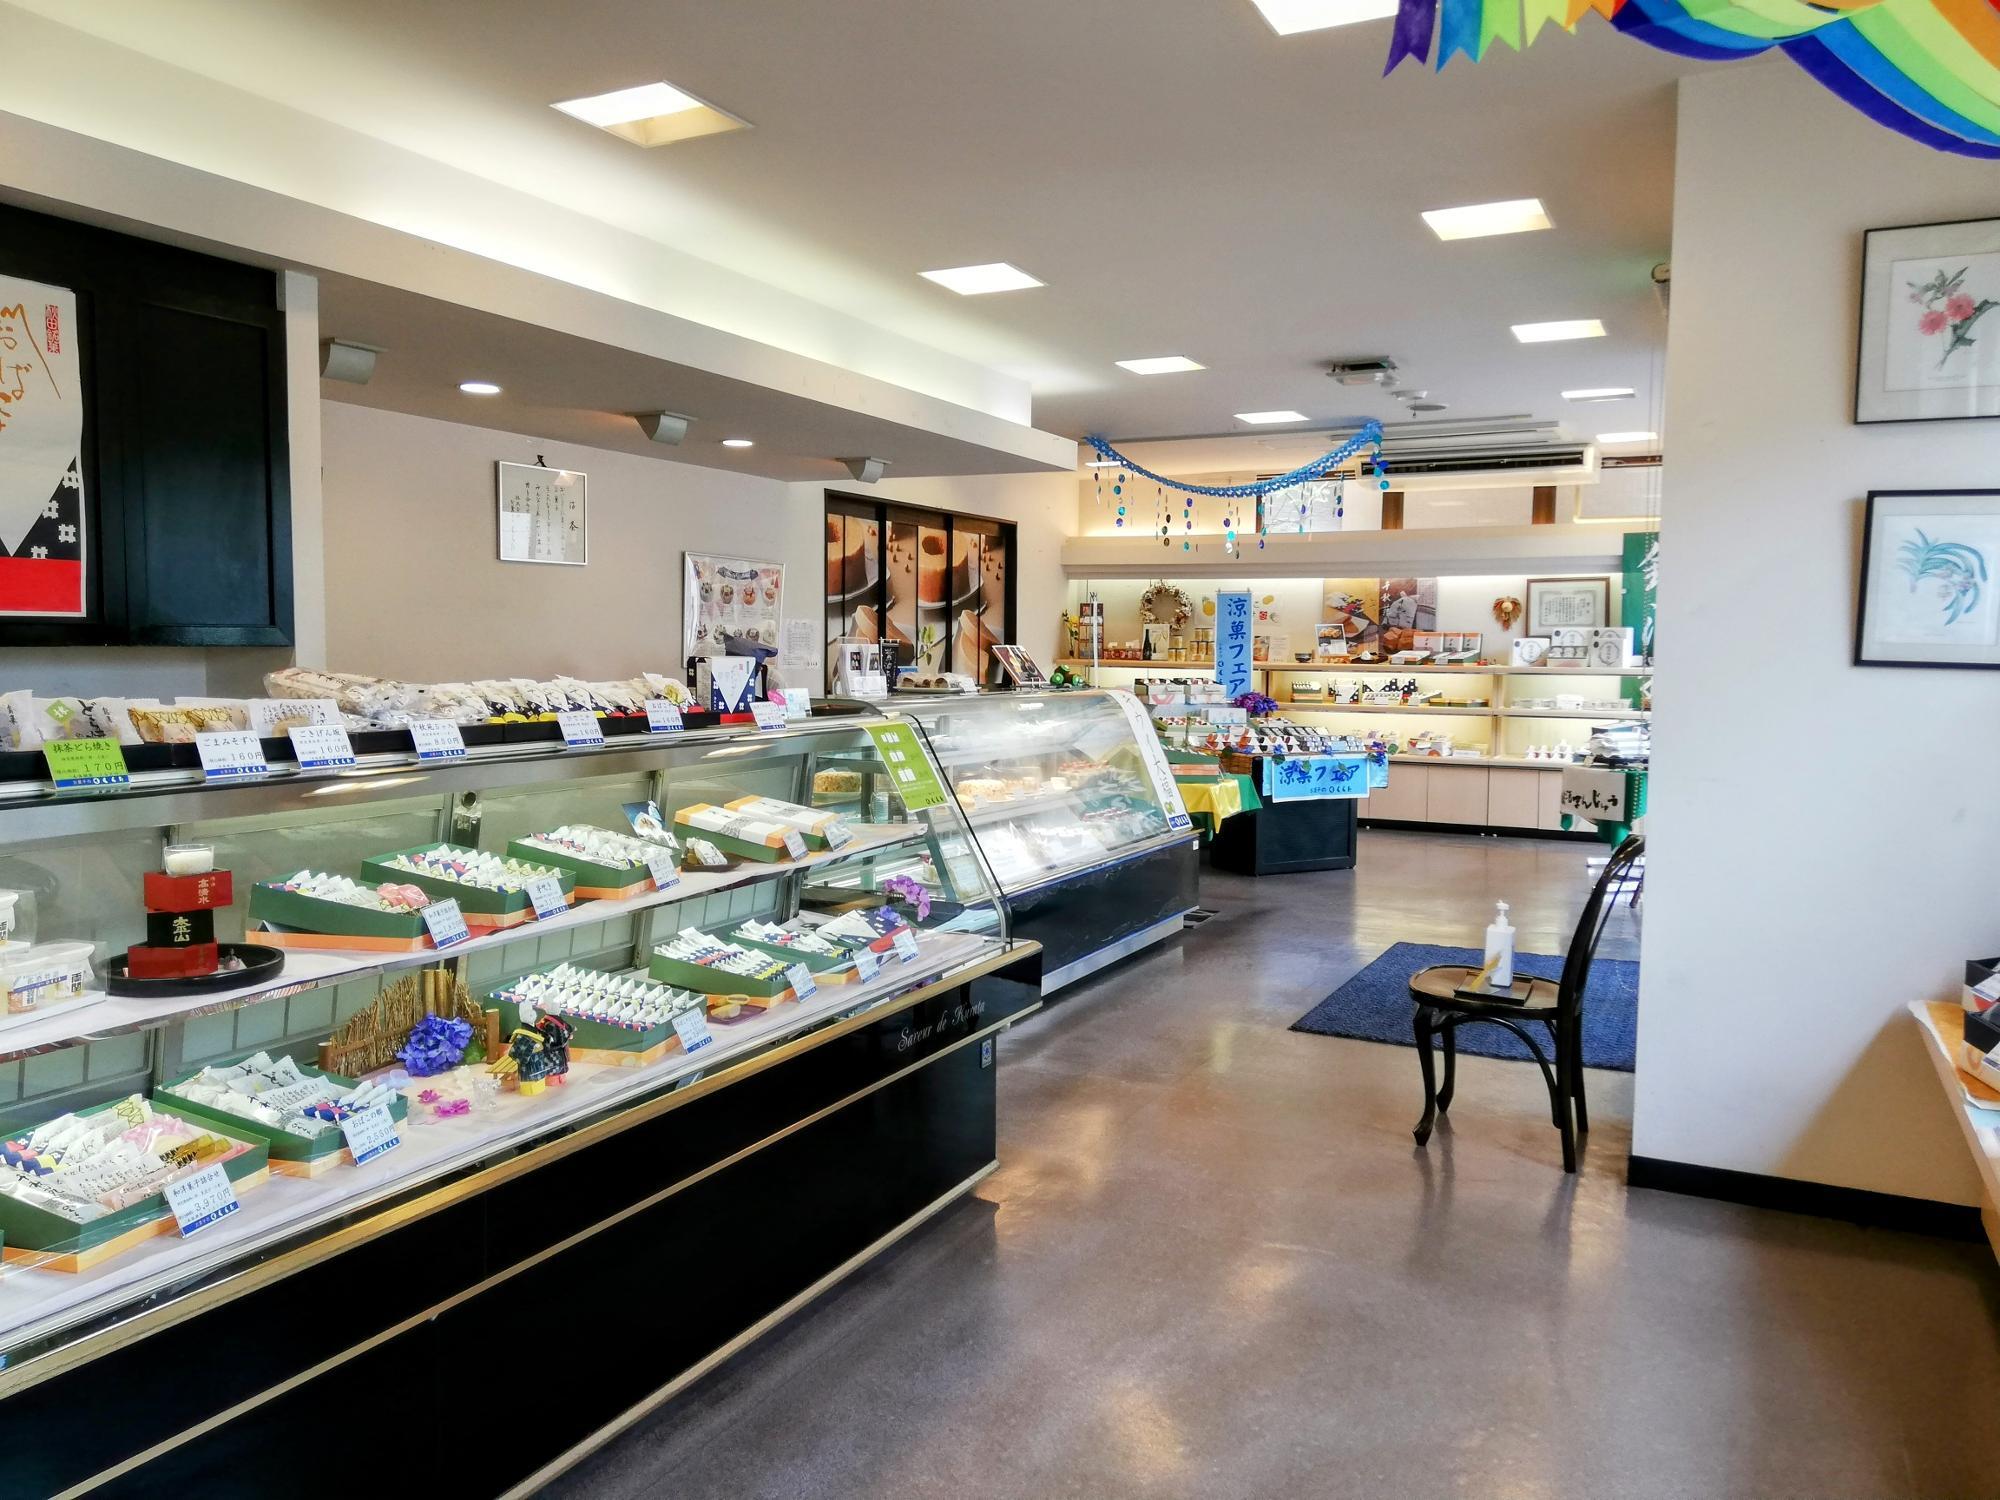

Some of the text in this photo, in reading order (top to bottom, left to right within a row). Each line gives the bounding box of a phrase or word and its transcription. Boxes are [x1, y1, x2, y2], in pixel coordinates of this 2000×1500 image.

[1228, 597, 1248, 696] 涼菓フェア
[173, 916, 192, 943] 太平山
